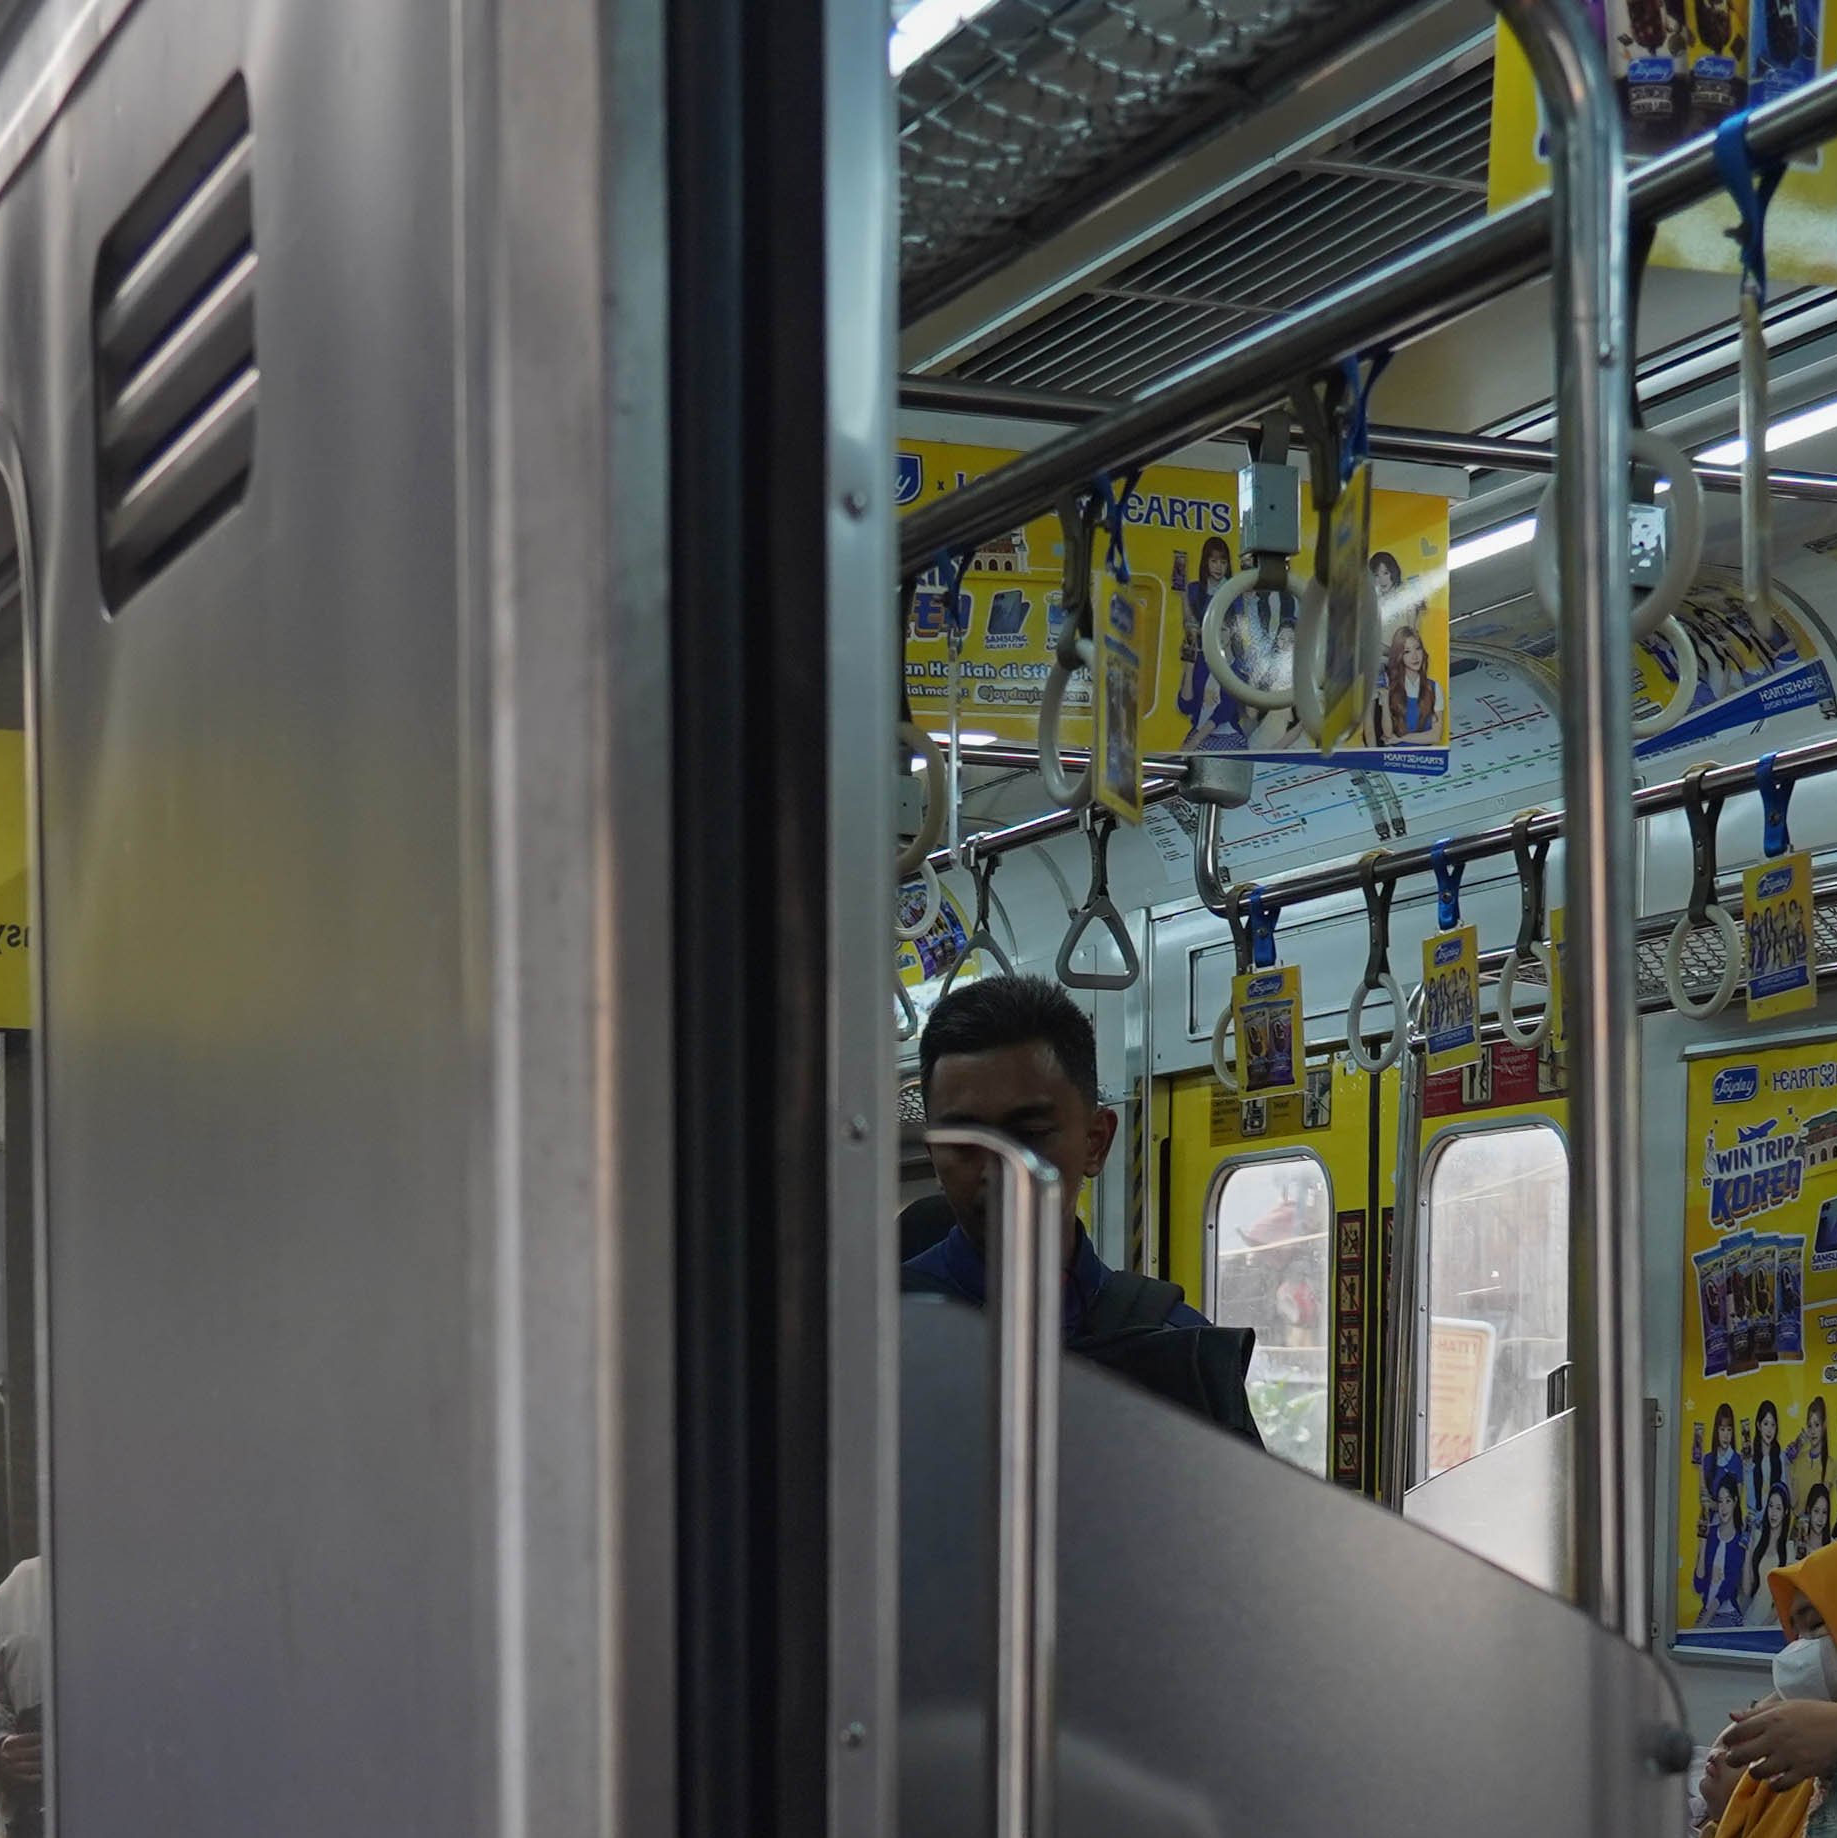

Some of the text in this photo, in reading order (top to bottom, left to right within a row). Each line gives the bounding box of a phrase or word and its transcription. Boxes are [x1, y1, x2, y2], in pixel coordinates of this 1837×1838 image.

[985, 635, 1028, 644] SAMSUNG
[1714, 1075, 1755, 1098] Joyday
[1716, 1135, 1796, 1173] WIN TRIP
[1712, 1159, 1803, 1228] KOREA
